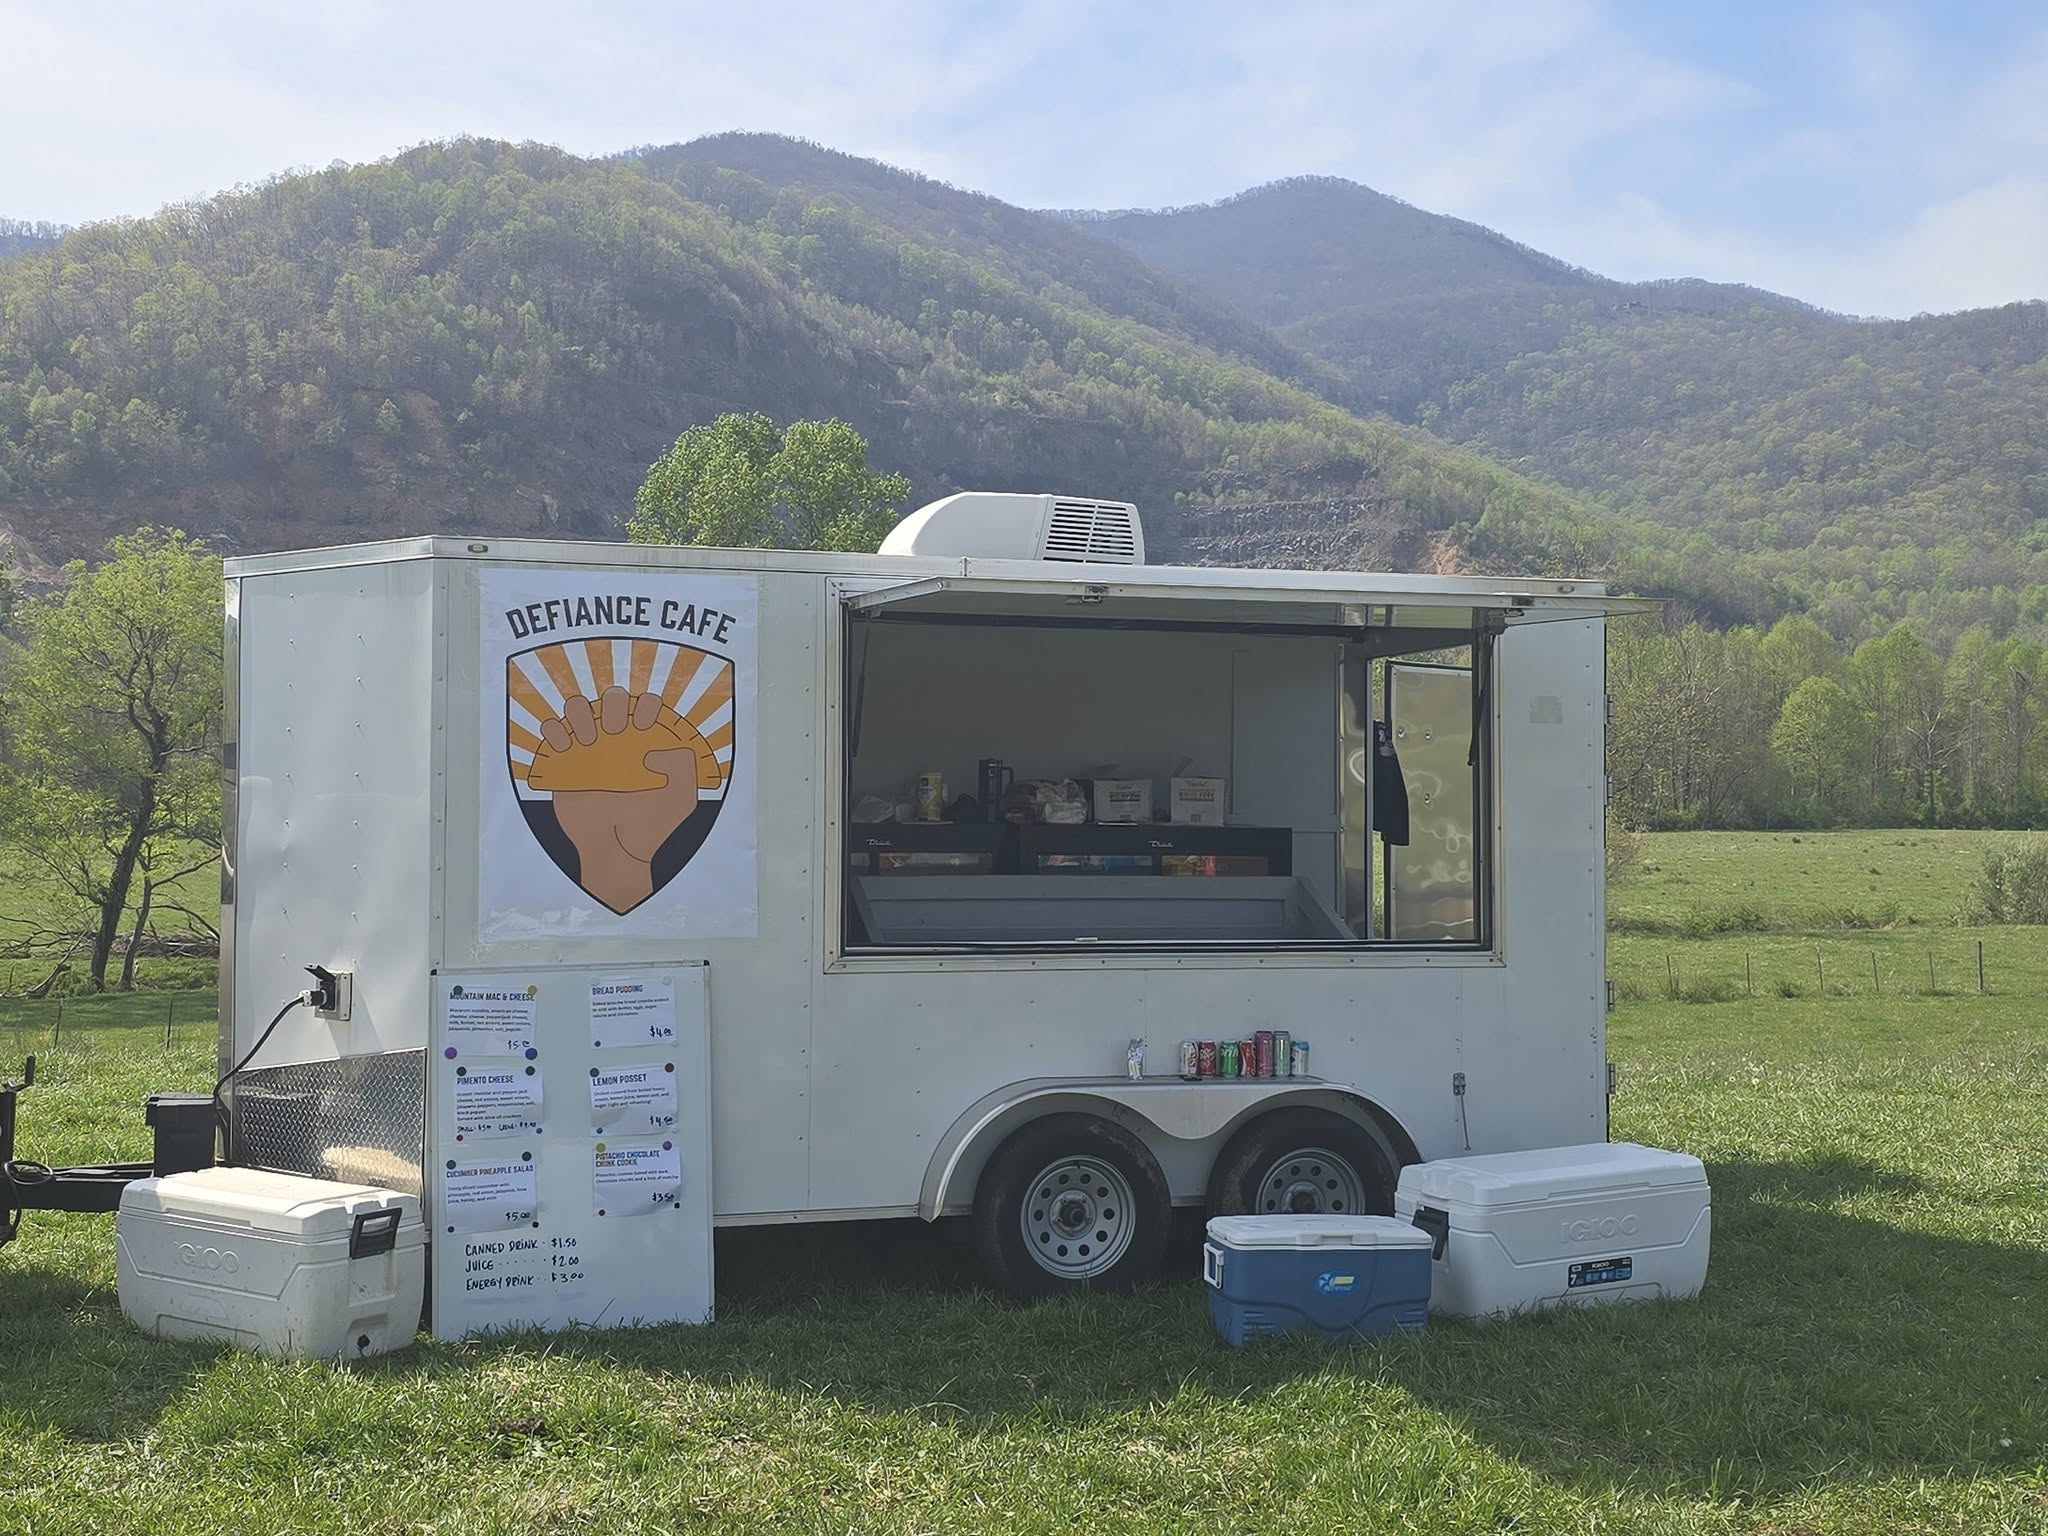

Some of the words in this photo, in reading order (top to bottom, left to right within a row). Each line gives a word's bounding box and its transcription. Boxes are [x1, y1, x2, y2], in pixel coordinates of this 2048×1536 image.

[505, 595, 652, 640] DEFIANCE
[660, 599, 737, 645] CAFE
[592, 986, 614, 995] BREAD
[616, 984, 644, 994] PUDDING
[449, 992, 484, 1001] MOUNTAIN
[485, 992, 501, 1001] MAC
[502, 993, 508, 1001] &
[509, 993, 536, 1002] CHEESE
[456, 1075, 487, 1085] PIMENTO
[488, 1075, 514, 1084] CHEESE
[592, 1076, 618, 1087] LEMON
[619, 1073, 647, 1084] POSSET
[595, 1151, 625, 1160] PISTACHIO
[626, 1150, 660, 1159] CHOCOLATE
[446, 1169, 478, 1178] CUCUMBER
[479, 1166, 512, 1176] PINEAPPLE
[513, 1165, 534, 1173] SALAD
[1561, 1214, 1641, 1245] IGLOO
[465, 1242, 505, 1257] CANNED
[551, 1237, 577, 1249] $1.50
[465, 1259, 494, 1273] JUICE
[551, 1254, 579, 1267] $2.00
[466, 1277, 503, 1291] ENERGY
[551, 1272, 584, 1283] $3.00
